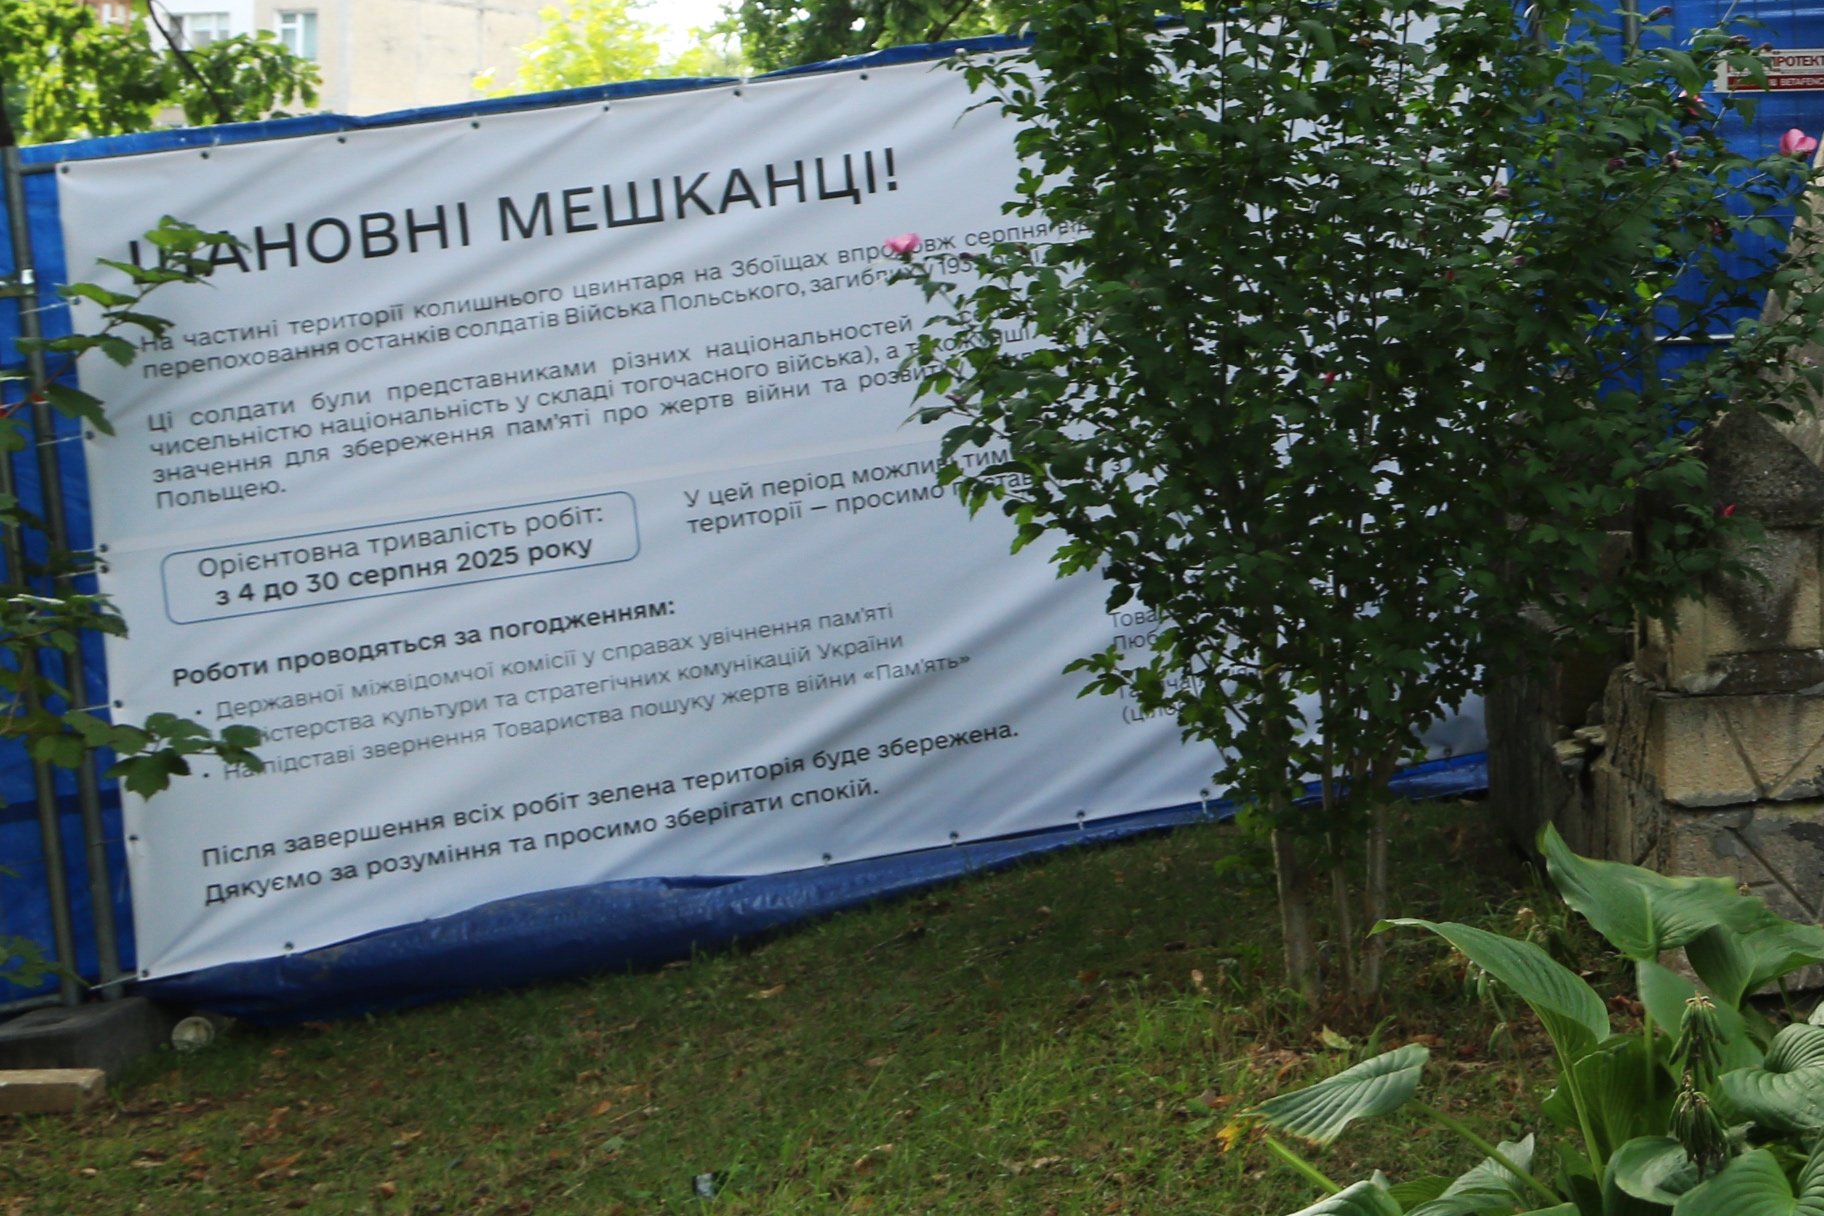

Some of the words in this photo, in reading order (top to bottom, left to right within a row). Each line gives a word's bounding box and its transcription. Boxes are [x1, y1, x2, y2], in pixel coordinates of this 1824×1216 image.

[498, 147, 898, 241] МЕШКАНЦІ!
[144, 341, 340, 379] перепоховання
[345, 325, 450, 354] останків
[455, 311, 559, 341] солдатів
[565, 300, 657, 326] Війська
[661, 282, 806, 312] Польського,
[811, 263, 914, 293] загибх
[938, 254, 974, 276] 193
[183, 320, 278, 346] частині
[287, 303, 404, 335] території
[413, 288, 563, 318] колишнього
[573, 271, 684, 299] цвинтаря
[694, 267, 722, 282] на
[731, 253, 828, 277] Збоїщах
[838, 234, 956, 265] впроовж
[965, 224, 1048, 247] серпня
[148, 411, 173, 432] Ці
[190, 400, 295, 426] солдати
[311, 391, 371, 412] були
[387, 361, 596, 402] представниками
[612, 348, 691, 375] різних
[706, 319, 912, 358] національностей
[150, 424, 312, 456] чисельністю
[321, 399, 509, 435] національність
[516, 396, 528, 413] у
[537, 380, 614, 406] складі
[621, 363, 769, 394] тогочасного
[777, 345, 879, 374] війська),
[886, 345, 899, 360] а
[905, 335, 976, 357] ткож
[153, 455, 272, 483] значення
[285, 448, 329, 468] для
[343, 426, 494, 458] збереження
[604, 405, 648, 425] про
[660, 394, 734, 415] жертв
[746, 383, 810, 404] війни
[821, 378, 847, 393] та
[858, 361, 965, 392] розвит
[157, 480, 286, 508] Польщею.
[684, 489, 699, 507] У
[709, 482, 753, 506] цей
[762, 473, 845, 497] період
[686, 500, 802, 534] території
[836, 485, 945, 515] просимо
[198, 542, 360, 579] Орієнтовна
[367, 521, 517, 556] тривалість
[525, 507, 603, 536] робіт:
[216, 590, 230, 606] з
[238, 583, 256, 601] 4
[263, 581, 298, 602] до
[306, 571, 339, 593] 30
[348, 559, 447, 587] серпня
[456, 546, 520, 572] 2025
[527, 539, 592, 566] року
[173, 660, 268, 687] Роботи
[277, 634, 446, 673] проводяться
[454, 629, 482, 646] за
[489, 601, 675, 640] погодженням:
[216, 685, 343, 721] Державної
[352, 662, 493, 697] міжвідомчої
[502, 650, 575, 675] комісії
[583, 651, 594, 668] у
[603, 637, 693, 661] справах
[700, 619, 811, 650] увічнення
[262, 713, 376, 742] істерства
[383, 698, 487, 727] культури
[494, 693, 518, 707] та
[525, 671, 670, 703] стратегічних
[678, 646, 810, 680] комунікацій
[817, 635, 903, 659] України
[263, 745, 355, 774] підставі
[363, 729, 485, 759] звернення
[493, 708, 623, 737] Товариства
[631, 695, 714, 718] пошуку
[722, 683, 789, 704] жертв
[797, 673, 856, 693] війни
[202, 842, 276, 867] Після
[284, 815, 445, 853] завершення
[453, 804, 504, 826] всіх
[513, 792, 580, 821] робіт
[587, 780, 676, 806] зелена
[682, 757, 806, 791] територія
[812, 745, 871, 771] буде
[877, 724, 1018, 758] збережена.
[205, 871, 322, 907] Дякуємо
[330, 865, 359, 882] за
[366, 842, 501, 879] розуміння
[508, 837, 537, 852] та
[544, 818, 657, 849] просимо
[665, 796, 783, 829] зберігати
[791, 778, 879, 807] спокій.
